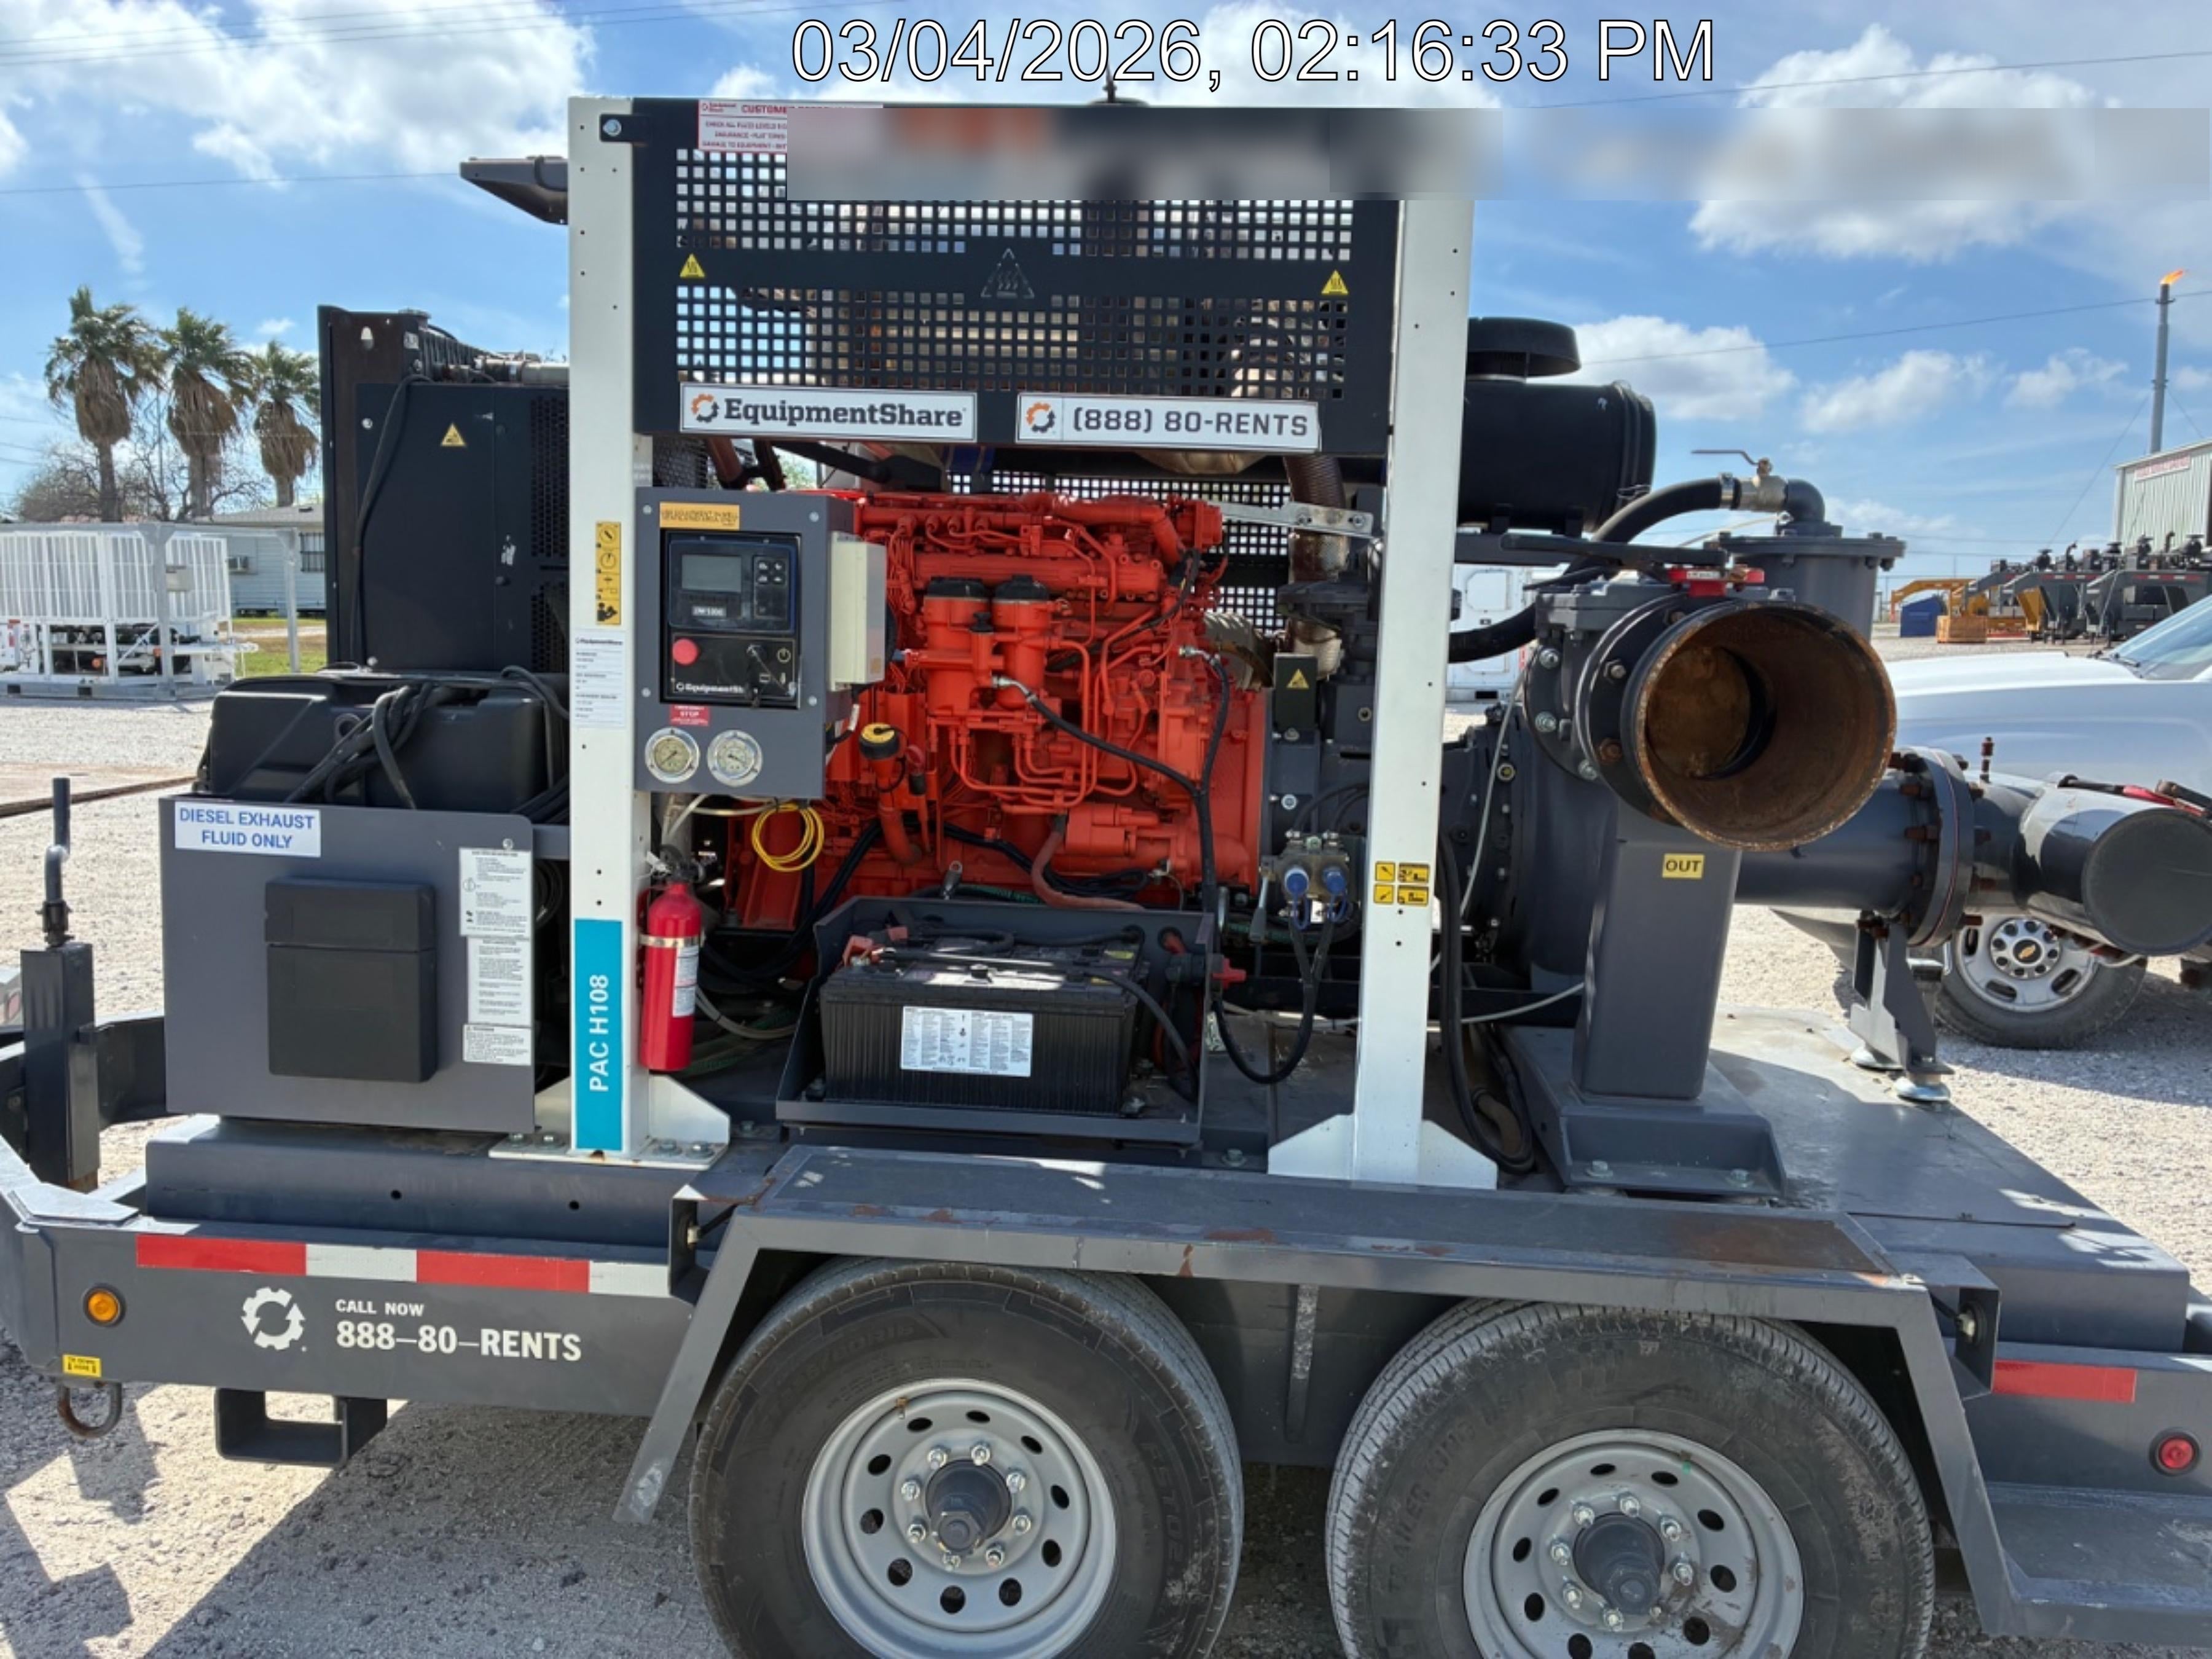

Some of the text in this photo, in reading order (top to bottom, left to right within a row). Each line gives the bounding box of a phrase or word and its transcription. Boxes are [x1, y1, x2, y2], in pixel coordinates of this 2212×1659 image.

[742, 104, 788, 114] CUSTOME
[724, 398, 963, 427] EquipmentShare
[1073, 407, 1308, 436] (888) 80-RENTS
[180, 809, 315, 829] DIESEL EXHAUST
[202, 830, 292, 849] FLUID ONLY
[1665, 860, 1701, 873] OUT
[589, 975, 609, 1092] PAC H108
[335, 1299, 425, 1317] CALL NOW
